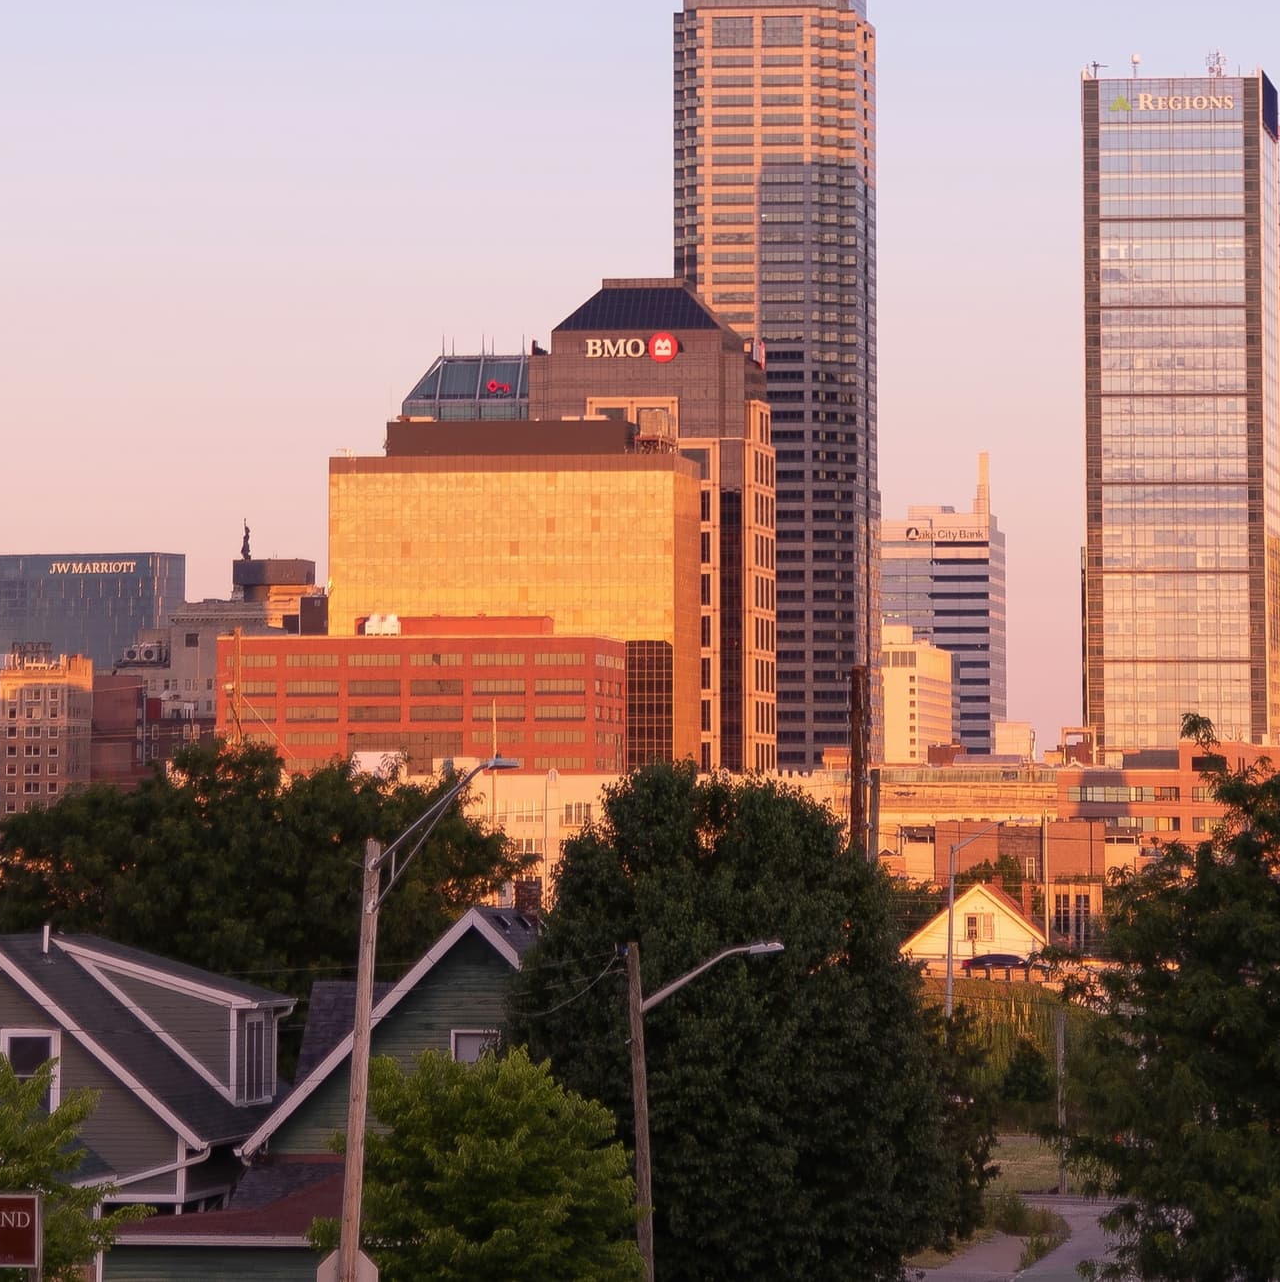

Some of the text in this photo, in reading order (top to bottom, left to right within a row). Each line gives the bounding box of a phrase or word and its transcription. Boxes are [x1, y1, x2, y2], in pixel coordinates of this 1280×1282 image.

[1138, 93, 1234, 111] REGIONS
[585, 338, 646, 358] BMO
[937, 529, 958, 541] City
[959, 529, 984, 539] Bank
[49, 561, 136, 574] JW MARRIOTT
